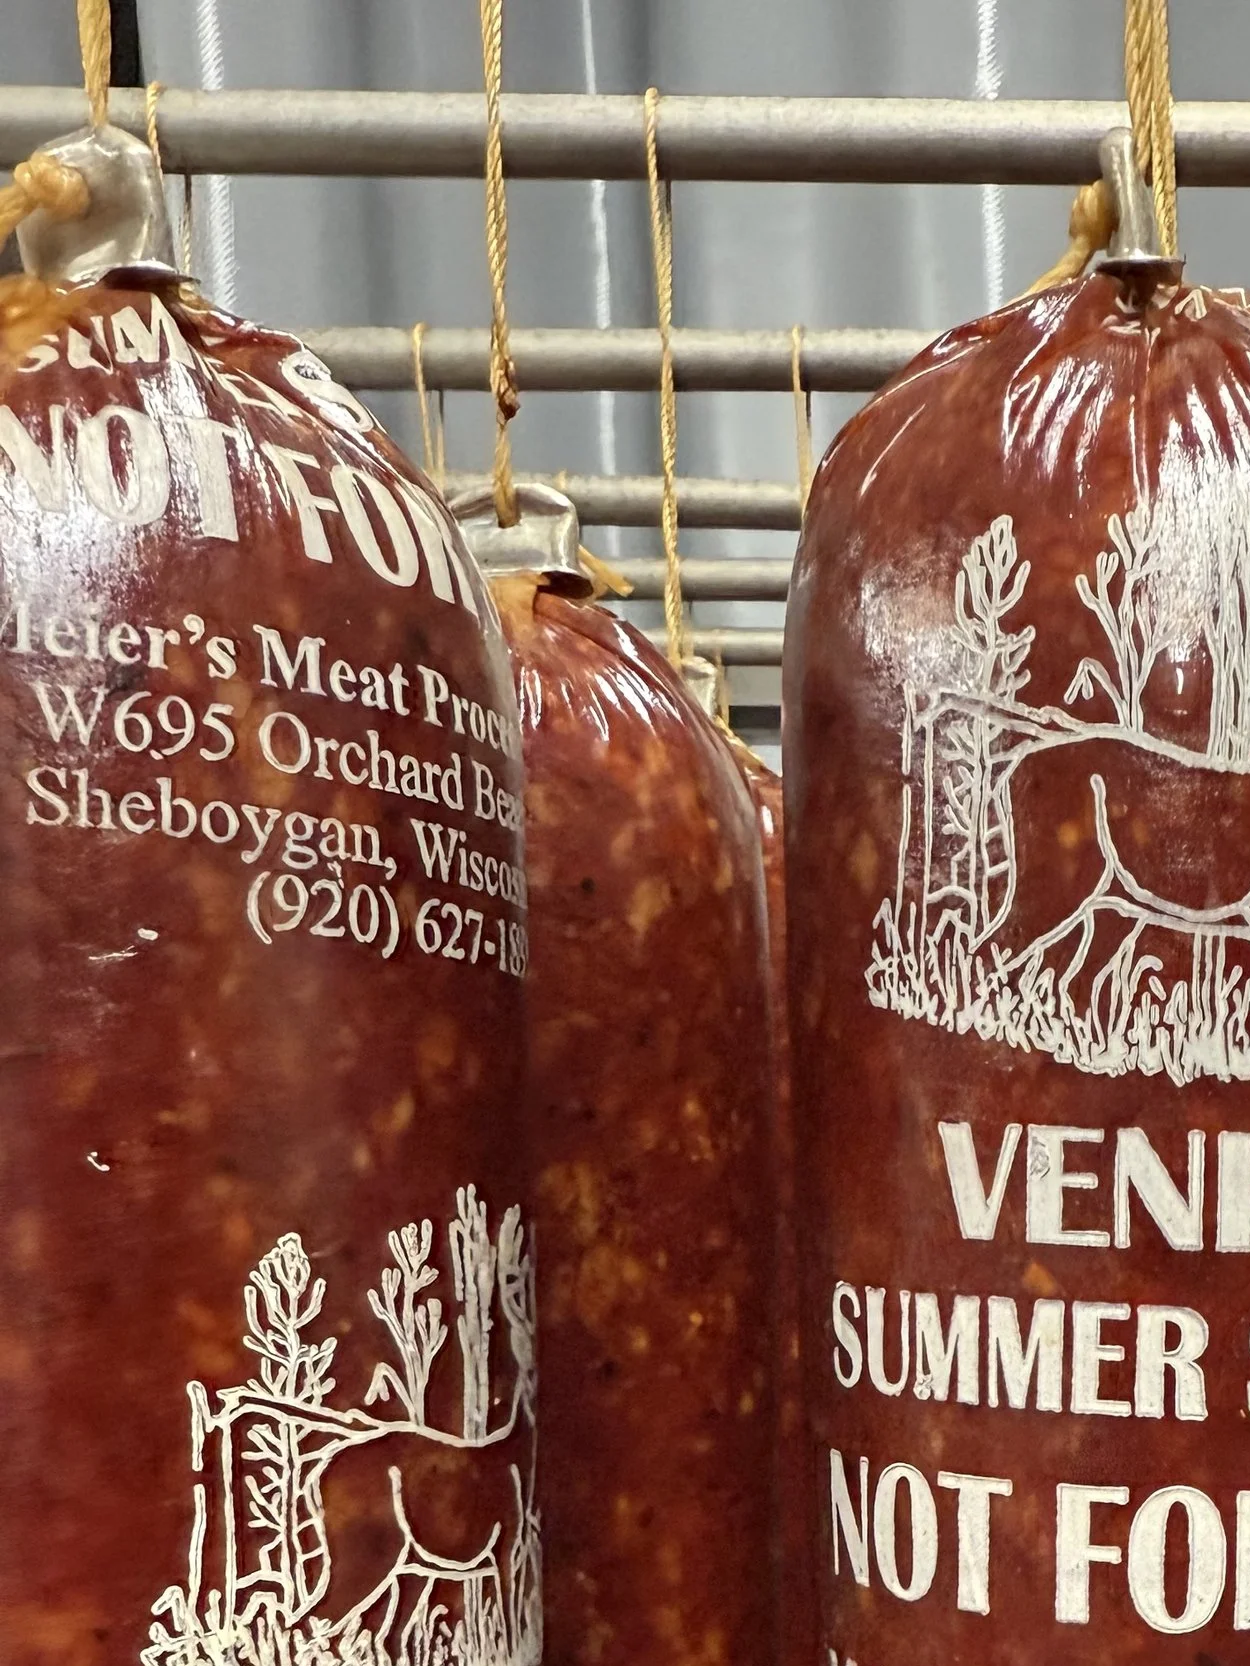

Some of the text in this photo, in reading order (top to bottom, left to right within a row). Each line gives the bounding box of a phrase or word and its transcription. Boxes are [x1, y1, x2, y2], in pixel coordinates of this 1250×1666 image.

[252, 624, 410, 717] Meat
[28, 678, 235, 761] W695
[259, 711, 464, 810] Orchard
[27, 766, 397, 880] Sheboygan,
[247, 870, 400, 959] (920)
[830, 1280, 1210, 1423] SUMMER
[829, 1446, 1014, 1616] NOT
